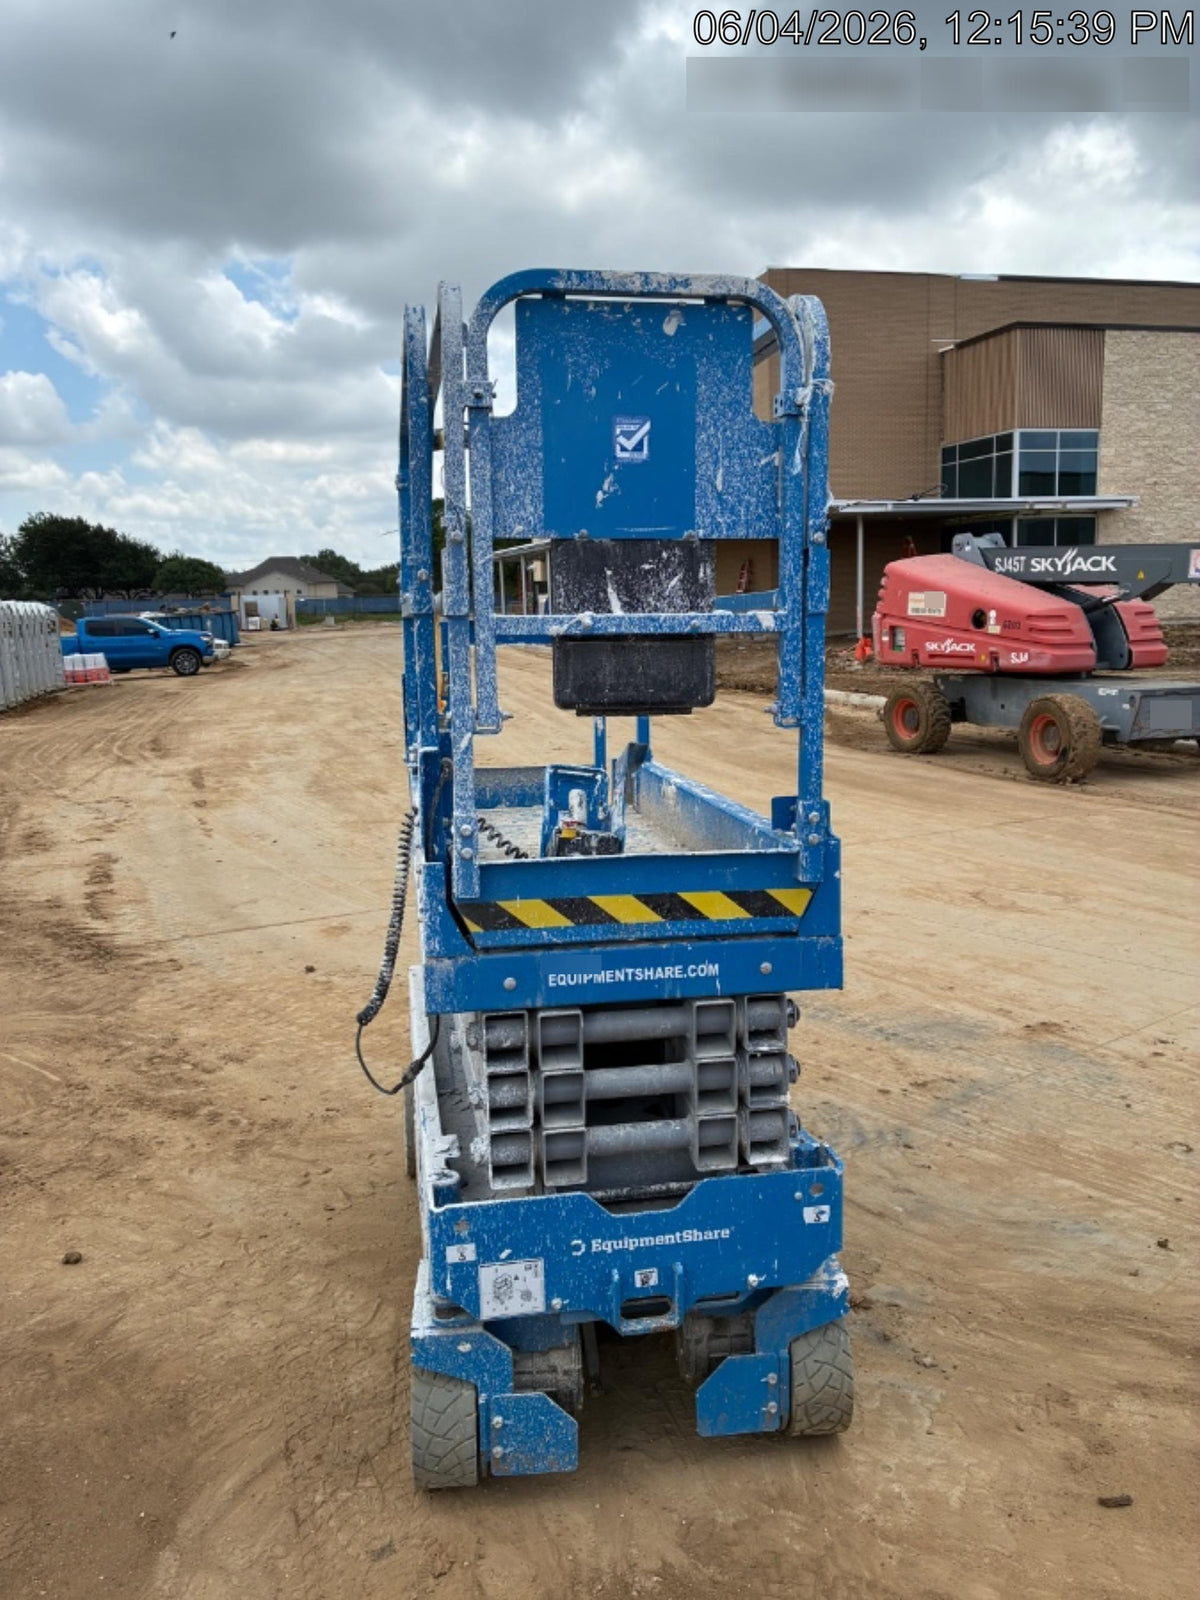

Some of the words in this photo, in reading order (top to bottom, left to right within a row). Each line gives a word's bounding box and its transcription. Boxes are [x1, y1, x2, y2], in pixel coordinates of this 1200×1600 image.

[995, 556, 1026, 573] SJ45T
[1030, 547, 1117, 575] SKYJACK
[925, 638, 976, 653] SKYJACK
[548, 963, 719, 987] EQUIPMENTSHARE.COM
[591, 1227, 731, 1253] EquipmentShare
